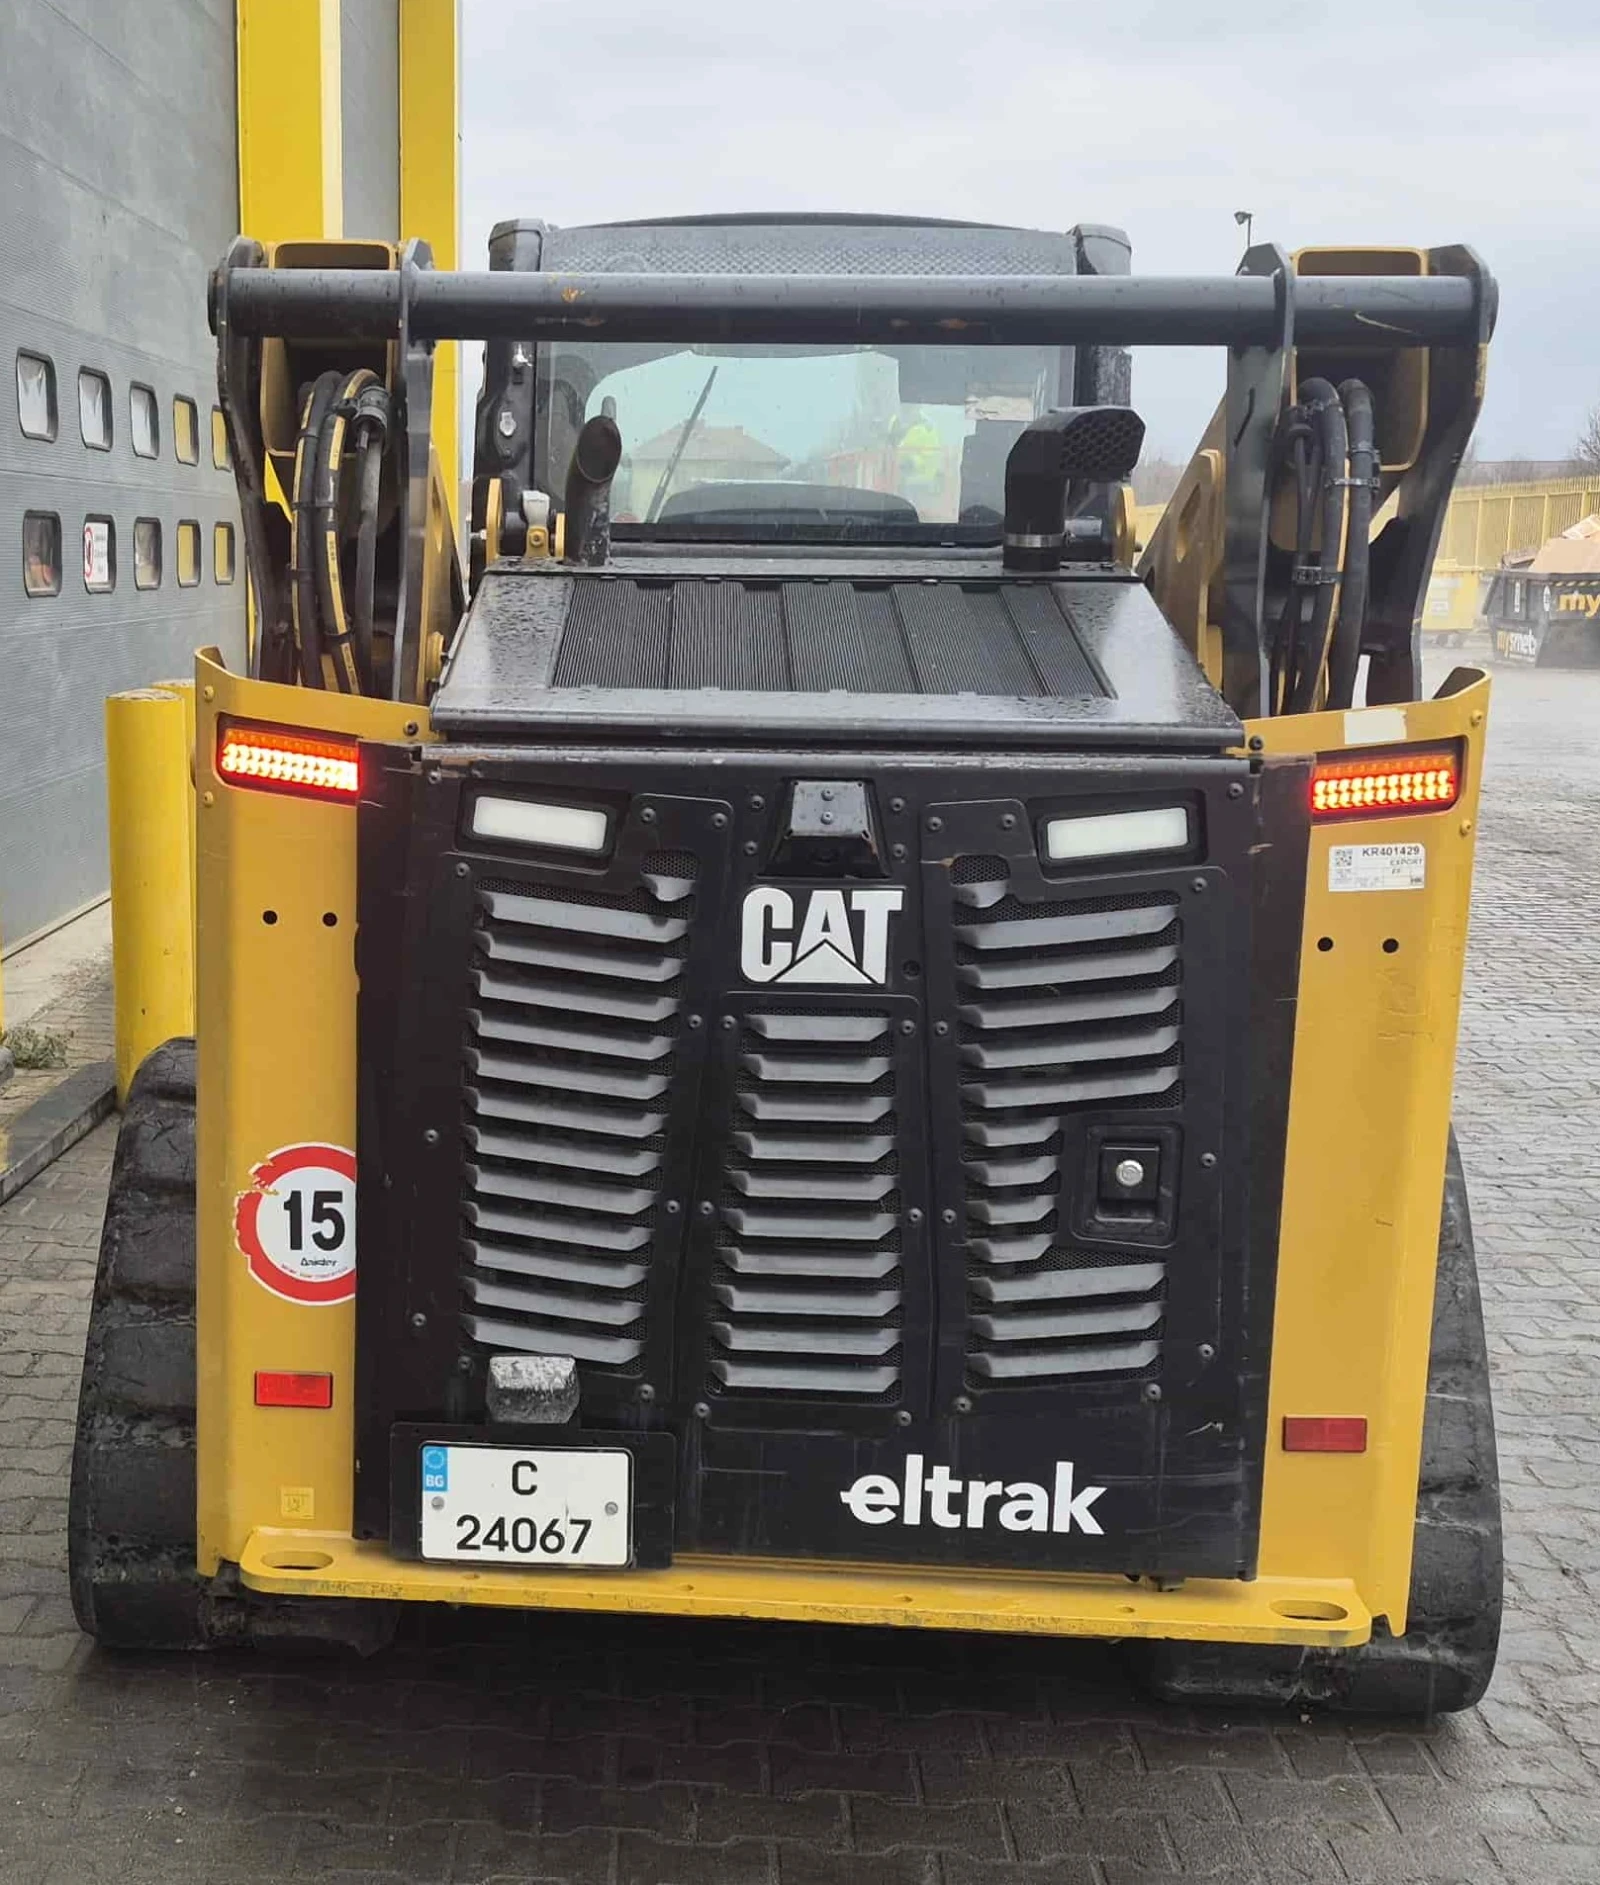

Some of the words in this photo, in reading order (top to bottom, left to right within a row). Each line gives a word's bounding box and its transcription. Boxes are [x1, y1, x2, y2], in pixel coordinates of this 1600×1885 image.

[1361, 845, 1420, 857] KR401429
[741, 887, 903, 984] CAT
[283, 1189, 346, 1251] 15
[425, 1474, 444, 1488] BG
[511, 1460, 538, 1496] C
[839, 1453, 1107, 1535] eltrak
[456, 1514, 592, 1554] 24067
